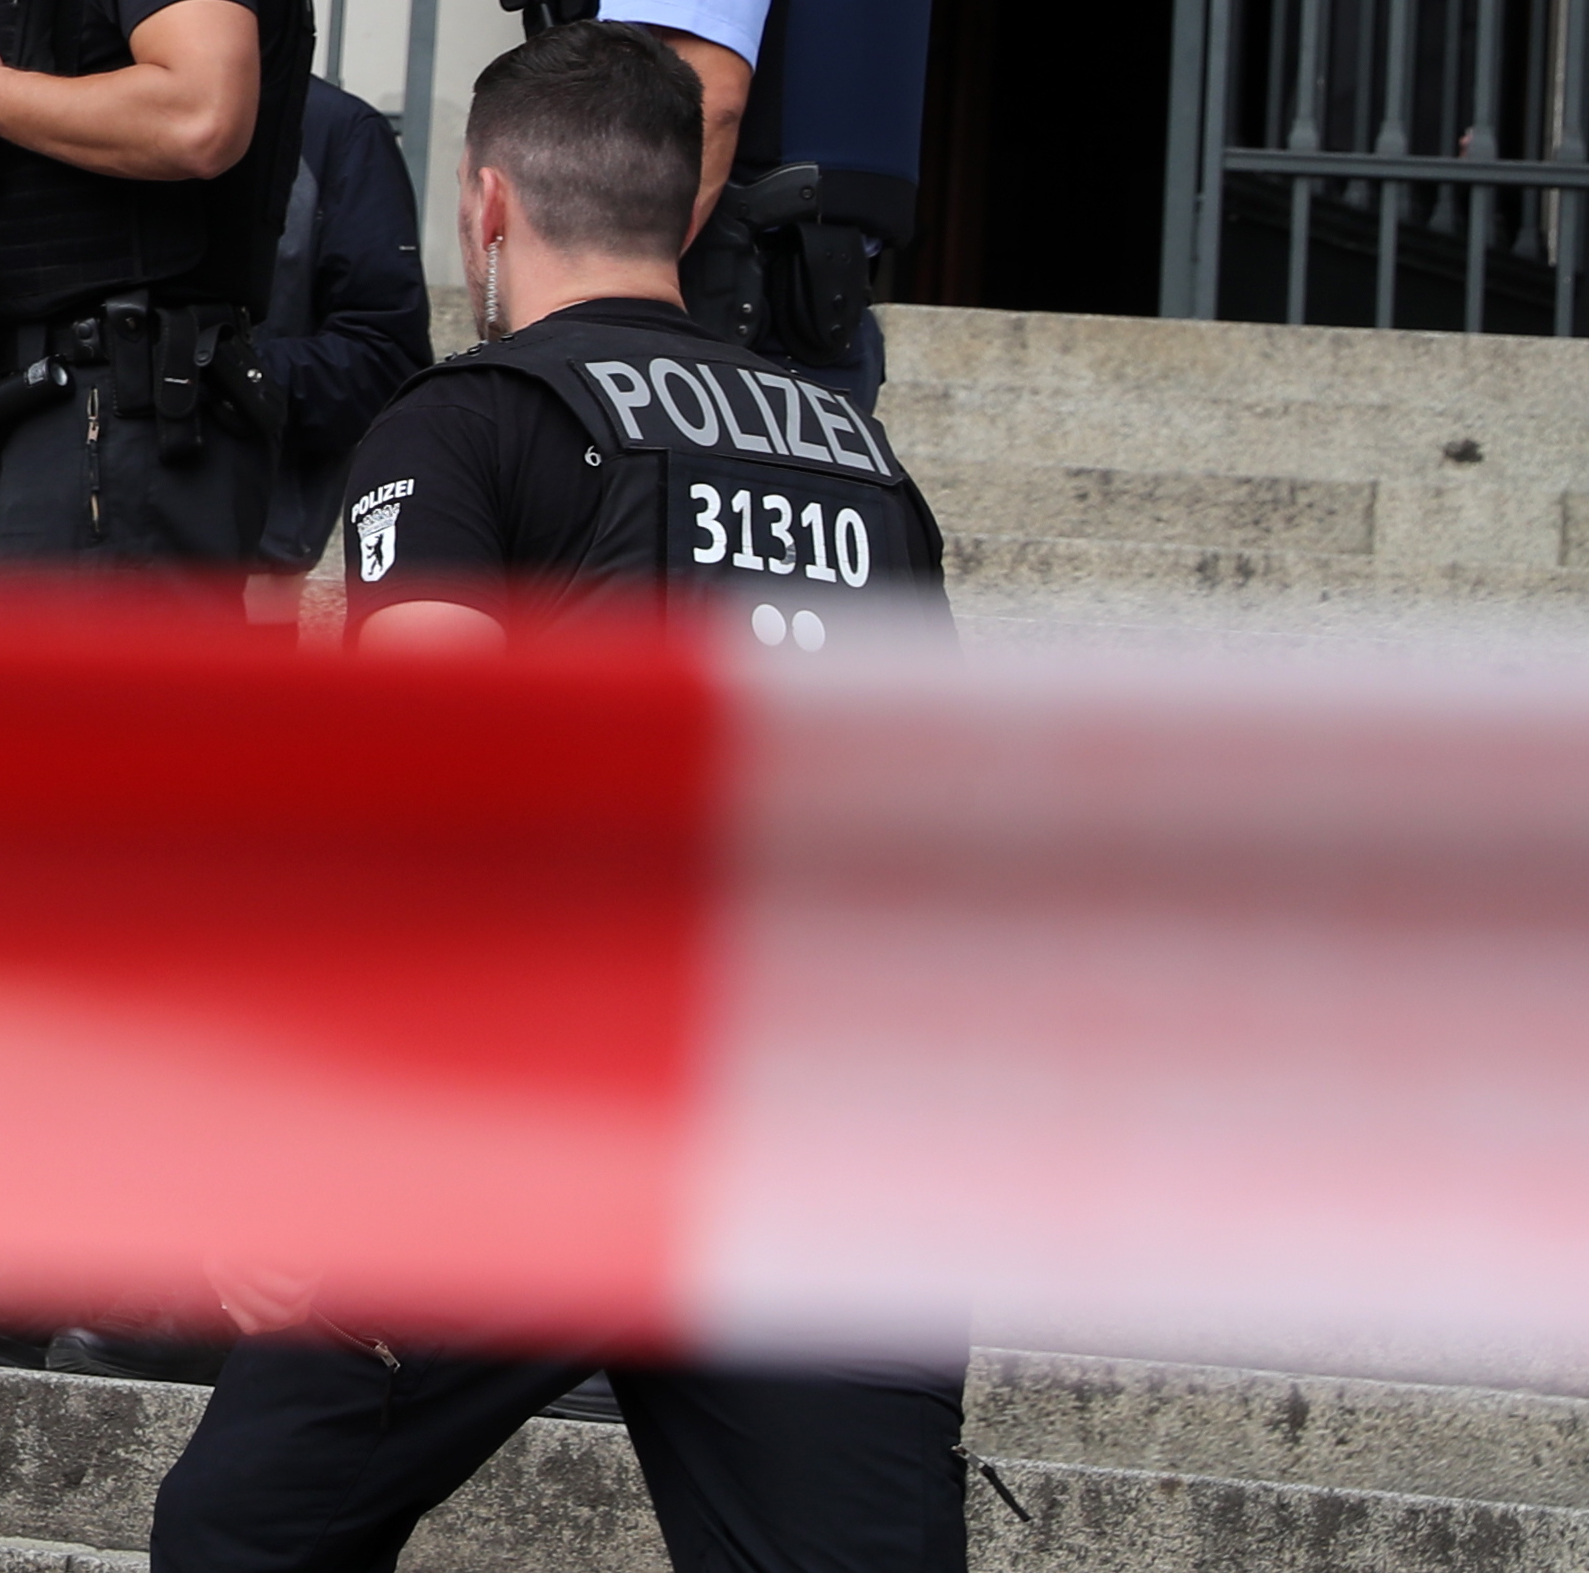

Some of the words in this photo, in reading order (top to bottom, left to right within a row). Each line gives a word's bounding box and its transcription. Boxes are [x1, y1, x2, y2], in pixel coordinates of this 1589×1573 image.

[585, 357, 892, 477] POLIZEI
[351, 479, 414, 523] POLIZEI
[689, 482, 871, 589] 31310
